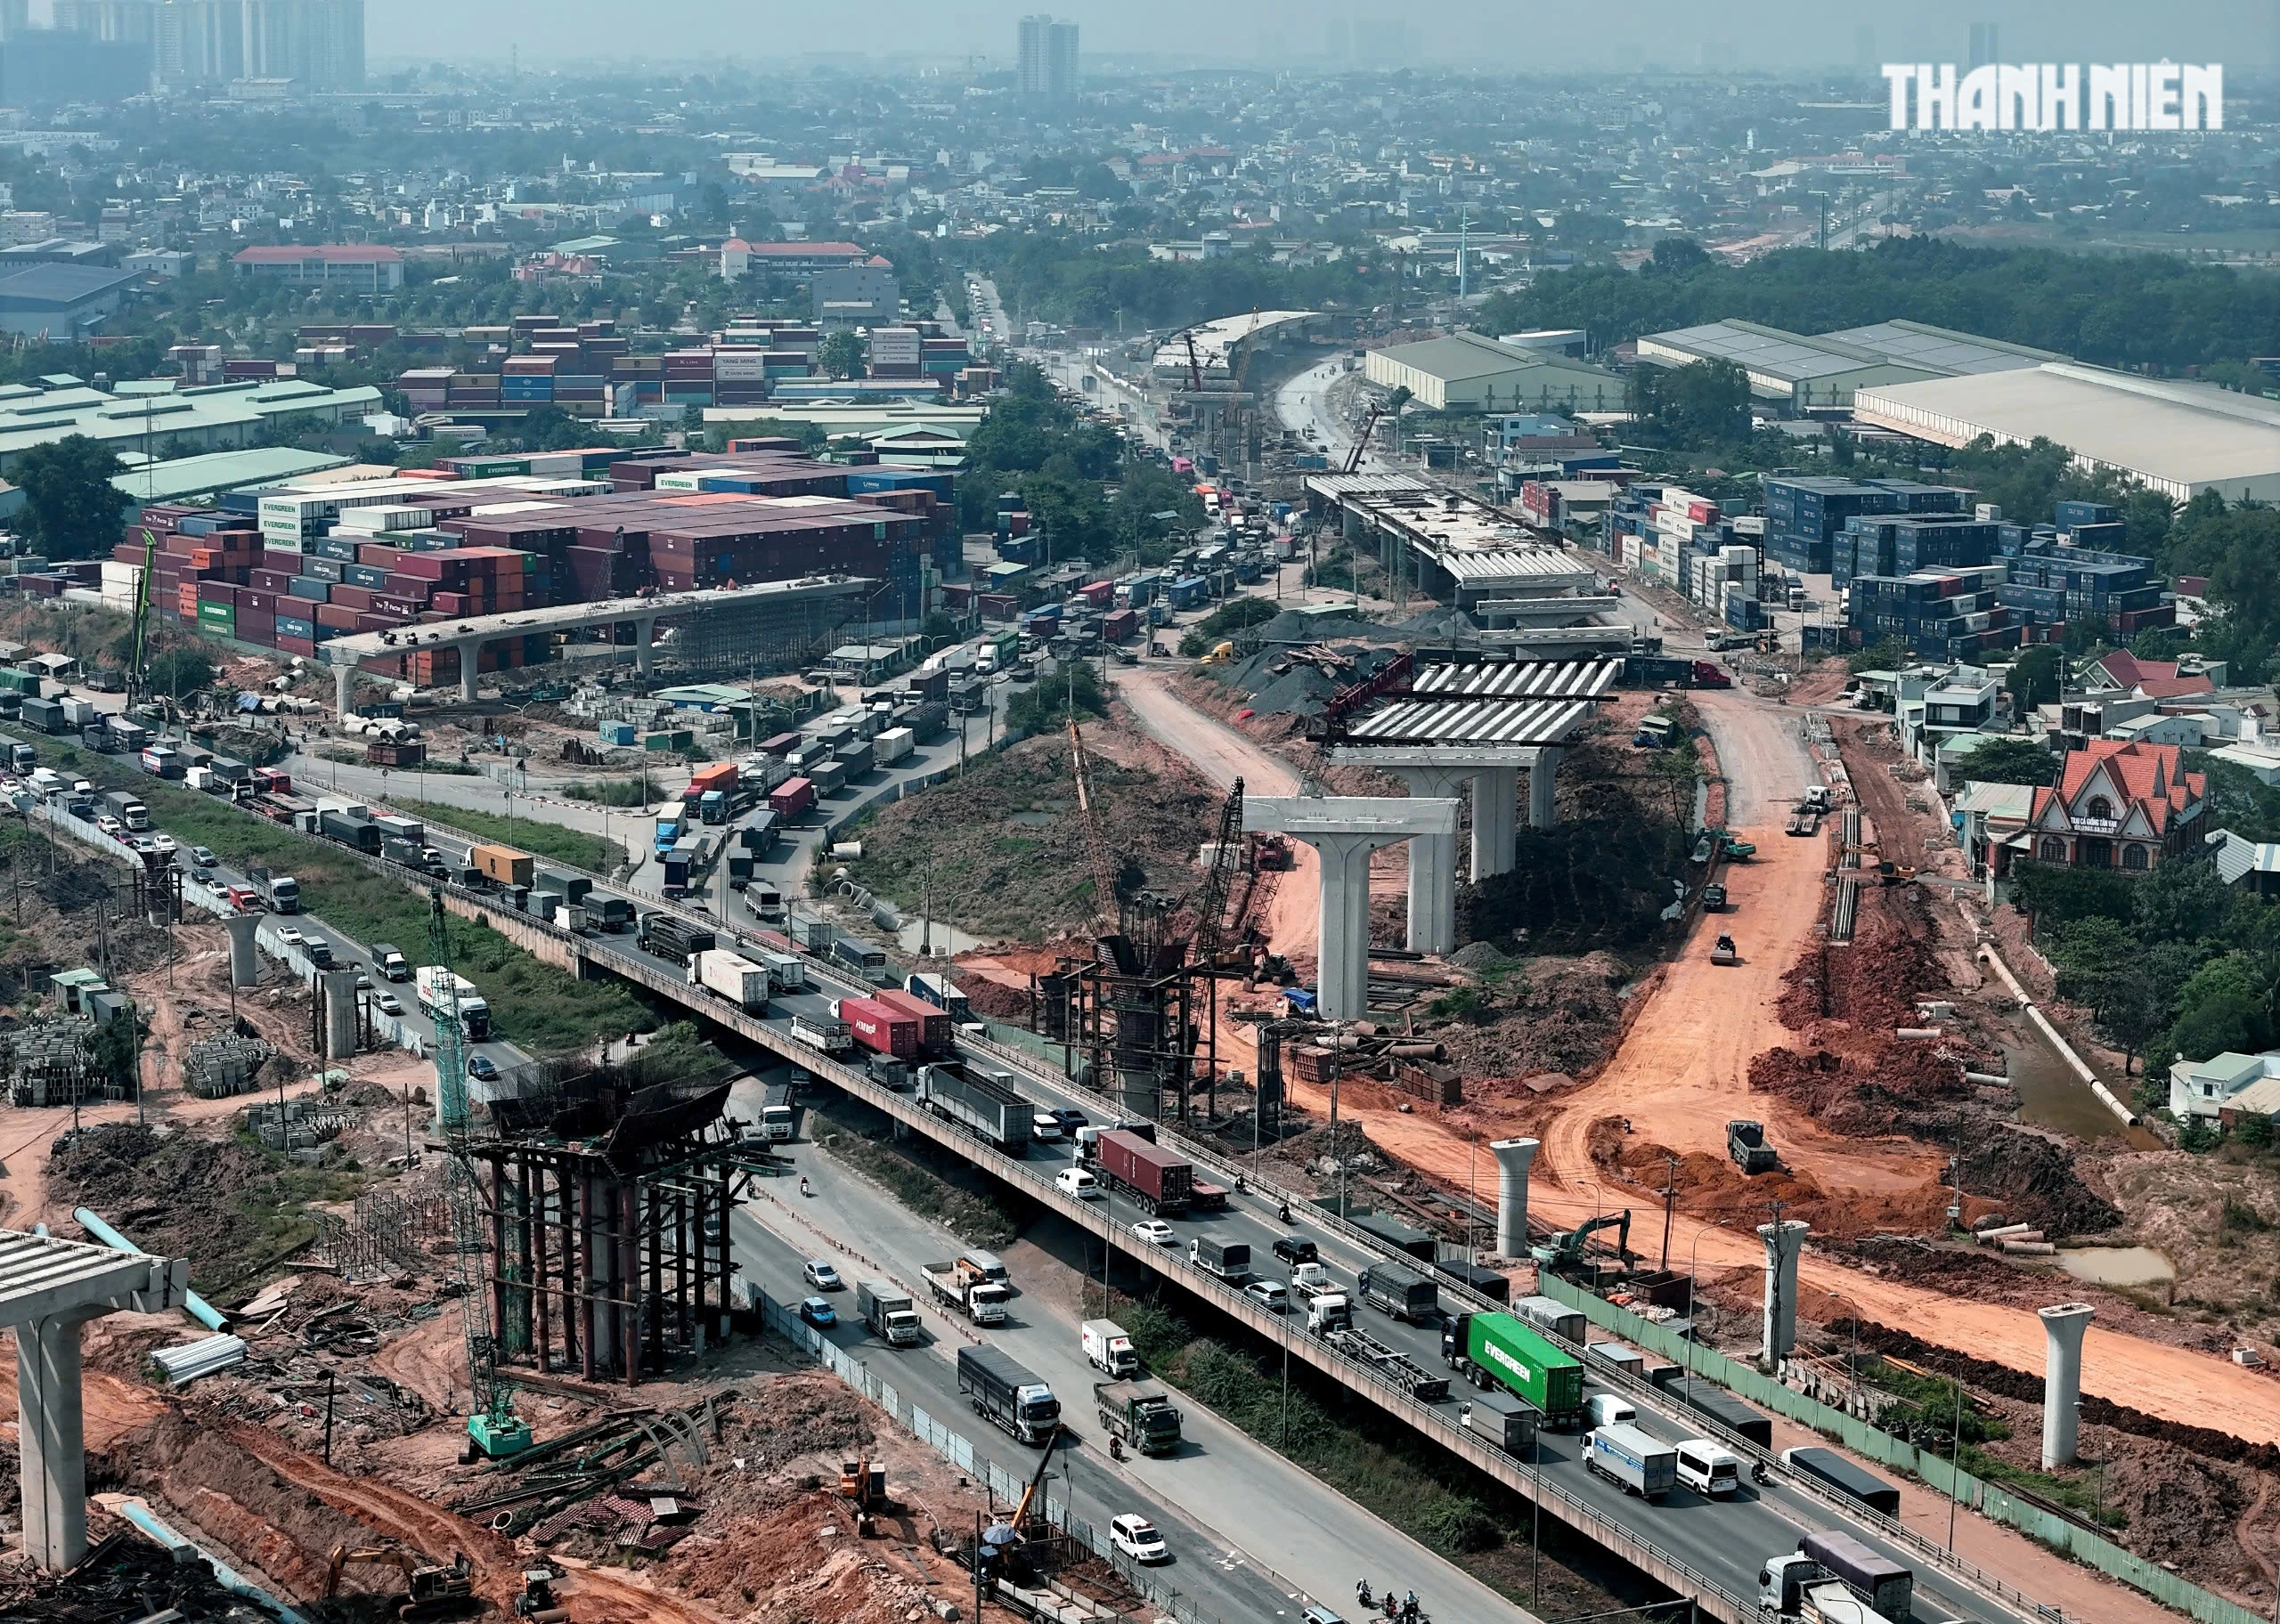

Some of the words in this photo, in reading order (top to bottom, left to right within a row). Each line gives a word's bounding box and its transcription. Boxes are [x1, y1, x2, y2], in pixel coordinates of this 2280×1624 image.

[487, 466, 519, 474] EVERGREEN
[660, 479, 693, 489] EVERGREEN
[264, 503, 296, 513] EVERGREEN
[264, 520, 296, 530] EVERGREEN
[265, 537, 297, 547] EVERGREEN
[204, 605, 227, 616] EVERGREEN
[1485, 1339, 1531, 1383] EVERGREEN
